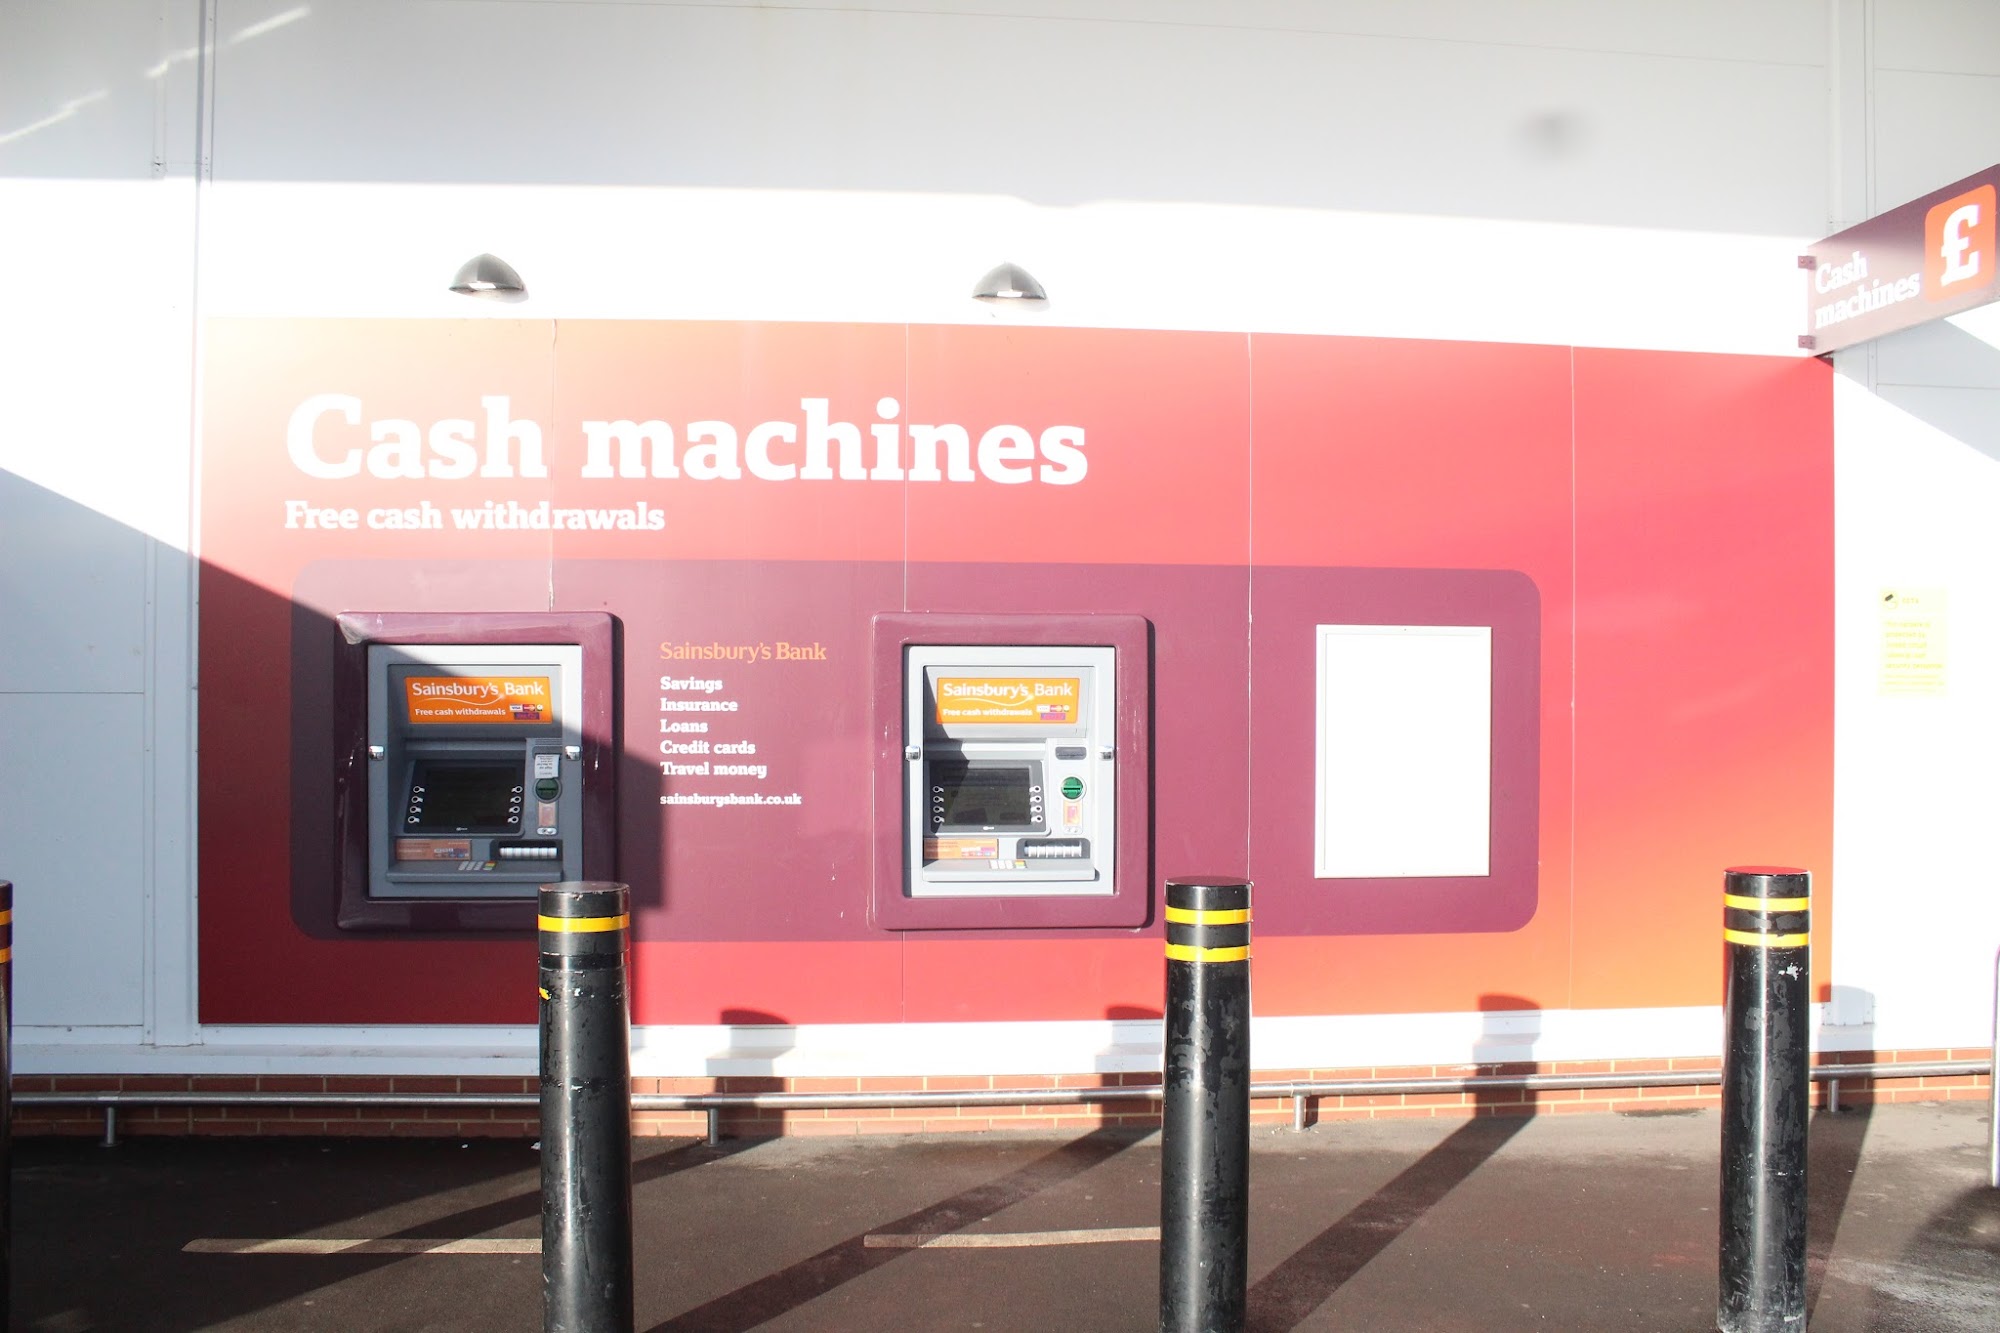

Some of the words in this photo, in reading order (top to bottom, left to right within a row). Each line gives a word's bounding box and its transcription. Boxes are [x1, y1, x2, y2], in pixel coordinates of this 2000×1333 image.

[1940, 204, 1981, 287] £
[1815, 251, 1868, 294] Cash
[1815, 273, 1921, 329] machines
[286, 393, 547, 479] Cash
[581, 397, 1088, 485] machines
[284, 500, 358, 529] Free
[366, 500, 442, 530] cash
[451, 500, 665, 531] withdrawals
[660, 642, 772, 663] Sainsbury's
[775, 642, 827, 660] Bank
[412, 682, 499, 698] Sainsbury's
[504, 682, 544, 696] Bank
[660, 676, 723, 693] Savings
[943, 683, 1028, 699] Sainsbury's
[1034, 683, 1072, 697] Bank
[415, 708, 433, 716] Free
[434, 708, 454, 716] cash
[455, 708, 506, 716] withdrawals
[660, 698, 738, 712] Insurance
[943, 708, 961, 716] Free
[961, 708, 982, 716] cash
[983, 708, 1033, 716] withdrawals
[660, 719, 708, 733] Loans
[660, 740, 710, 754] Credit
[713, 740, 756, 754] cards
[660, 761, 709, 775] Travel
[713, 764, 767, 778] money
[660, 793, 802, 807] sainsburysbank.co.uk
